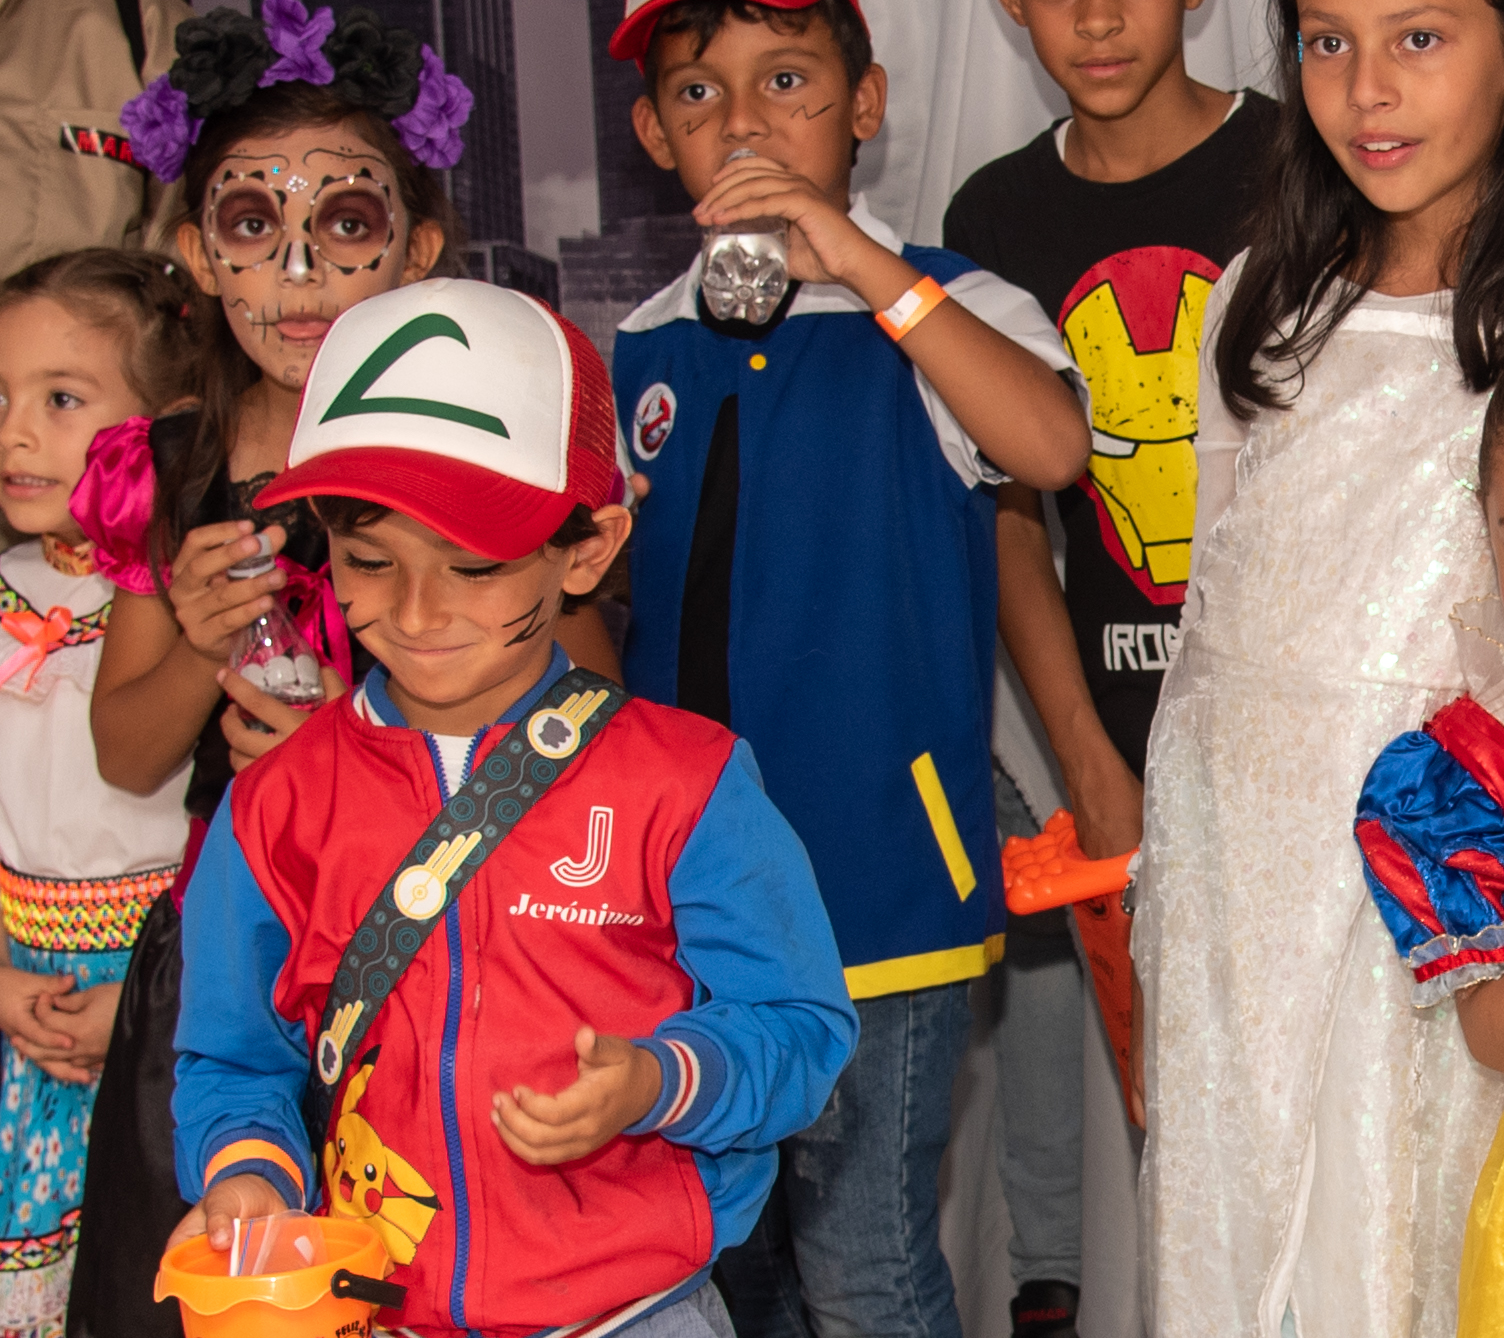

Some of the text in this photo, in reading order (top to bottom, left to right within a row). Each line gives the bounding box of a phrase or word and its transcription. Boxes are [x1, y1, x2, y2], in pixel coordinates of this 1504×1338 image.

[549, 805, 613, 887] J
[509, 893, 644, 926] Jerónimo
[335, 1320, 360, 1338] FELIZ
